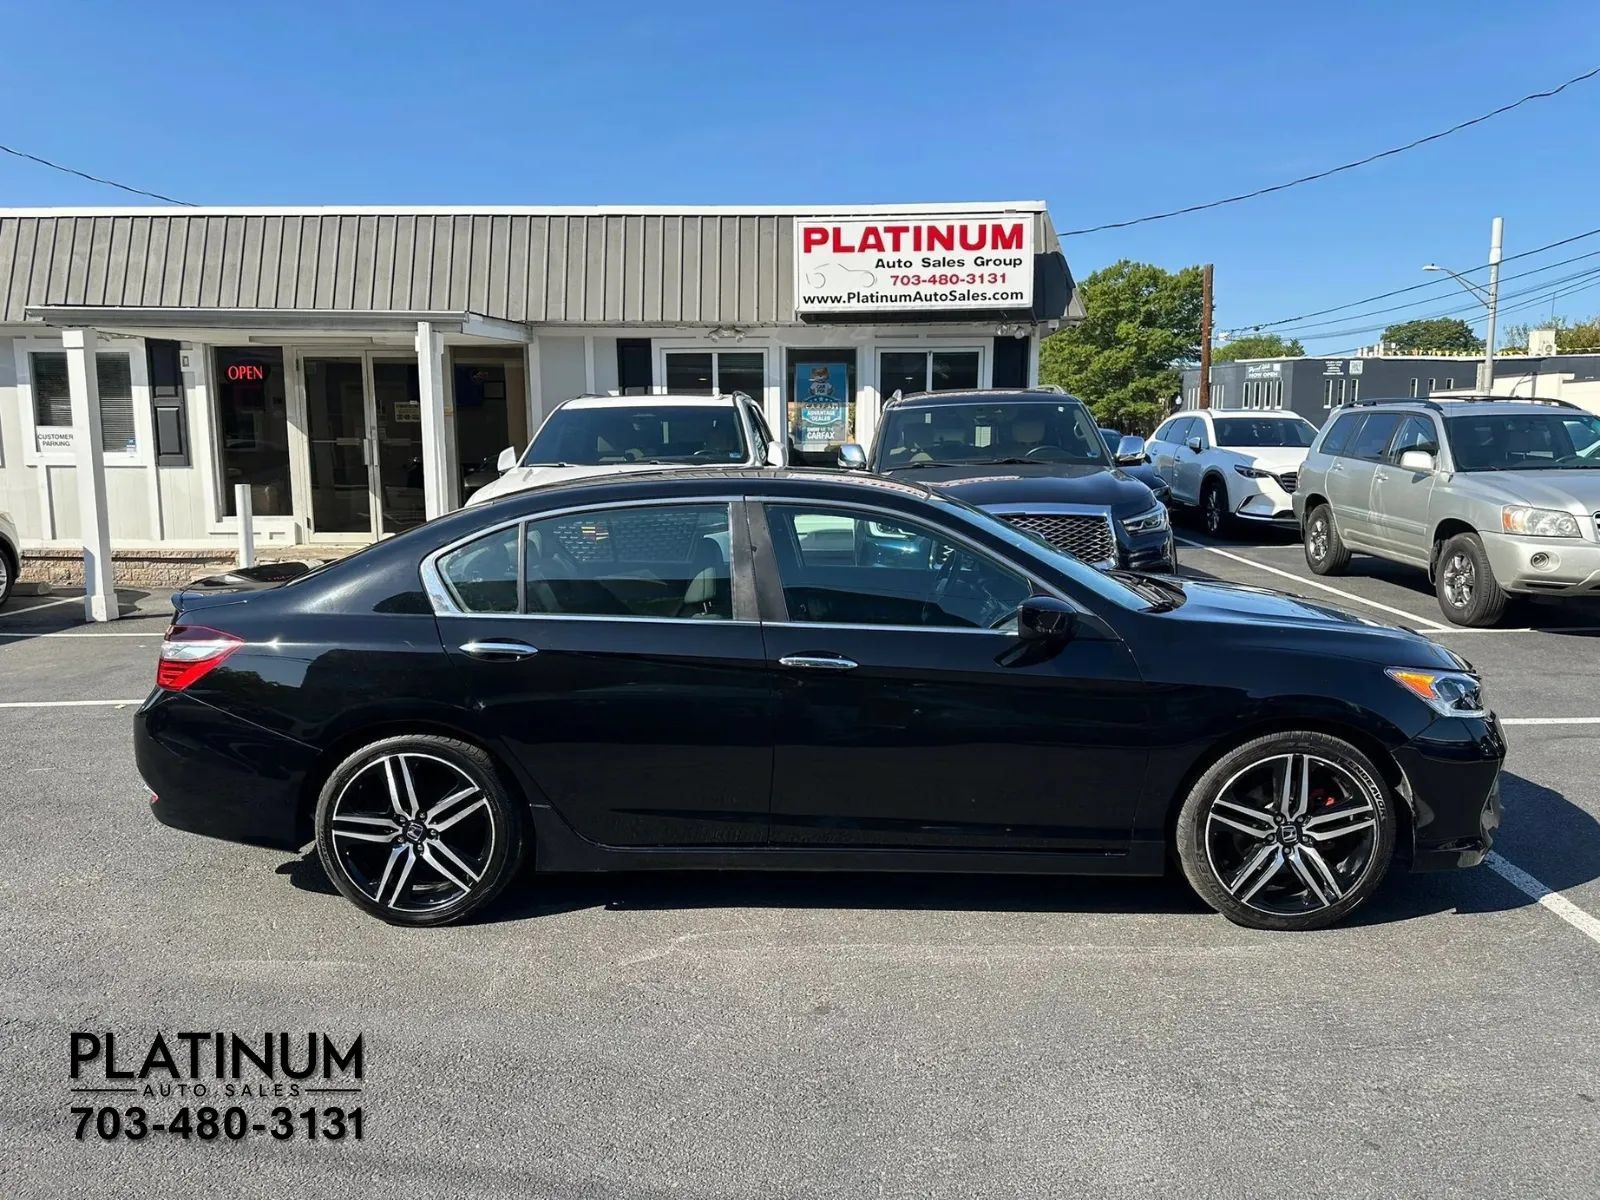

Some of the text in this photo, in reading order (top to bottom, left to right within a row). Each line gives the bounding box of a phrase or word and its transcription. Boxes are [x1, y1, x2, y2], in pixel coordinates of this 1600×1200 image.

[803, 223, 1023, 253] PLATINUM
[875, 256, 1023, 270] Auto Sales Group
[890, 273, 1007, 286] 703-480-3131
[803, 289, 1024, 304] www.PlatinumAutoSales.com
[228, 365, 263, 380] OPEN
[807, 432, 835, 440] CARFAX
